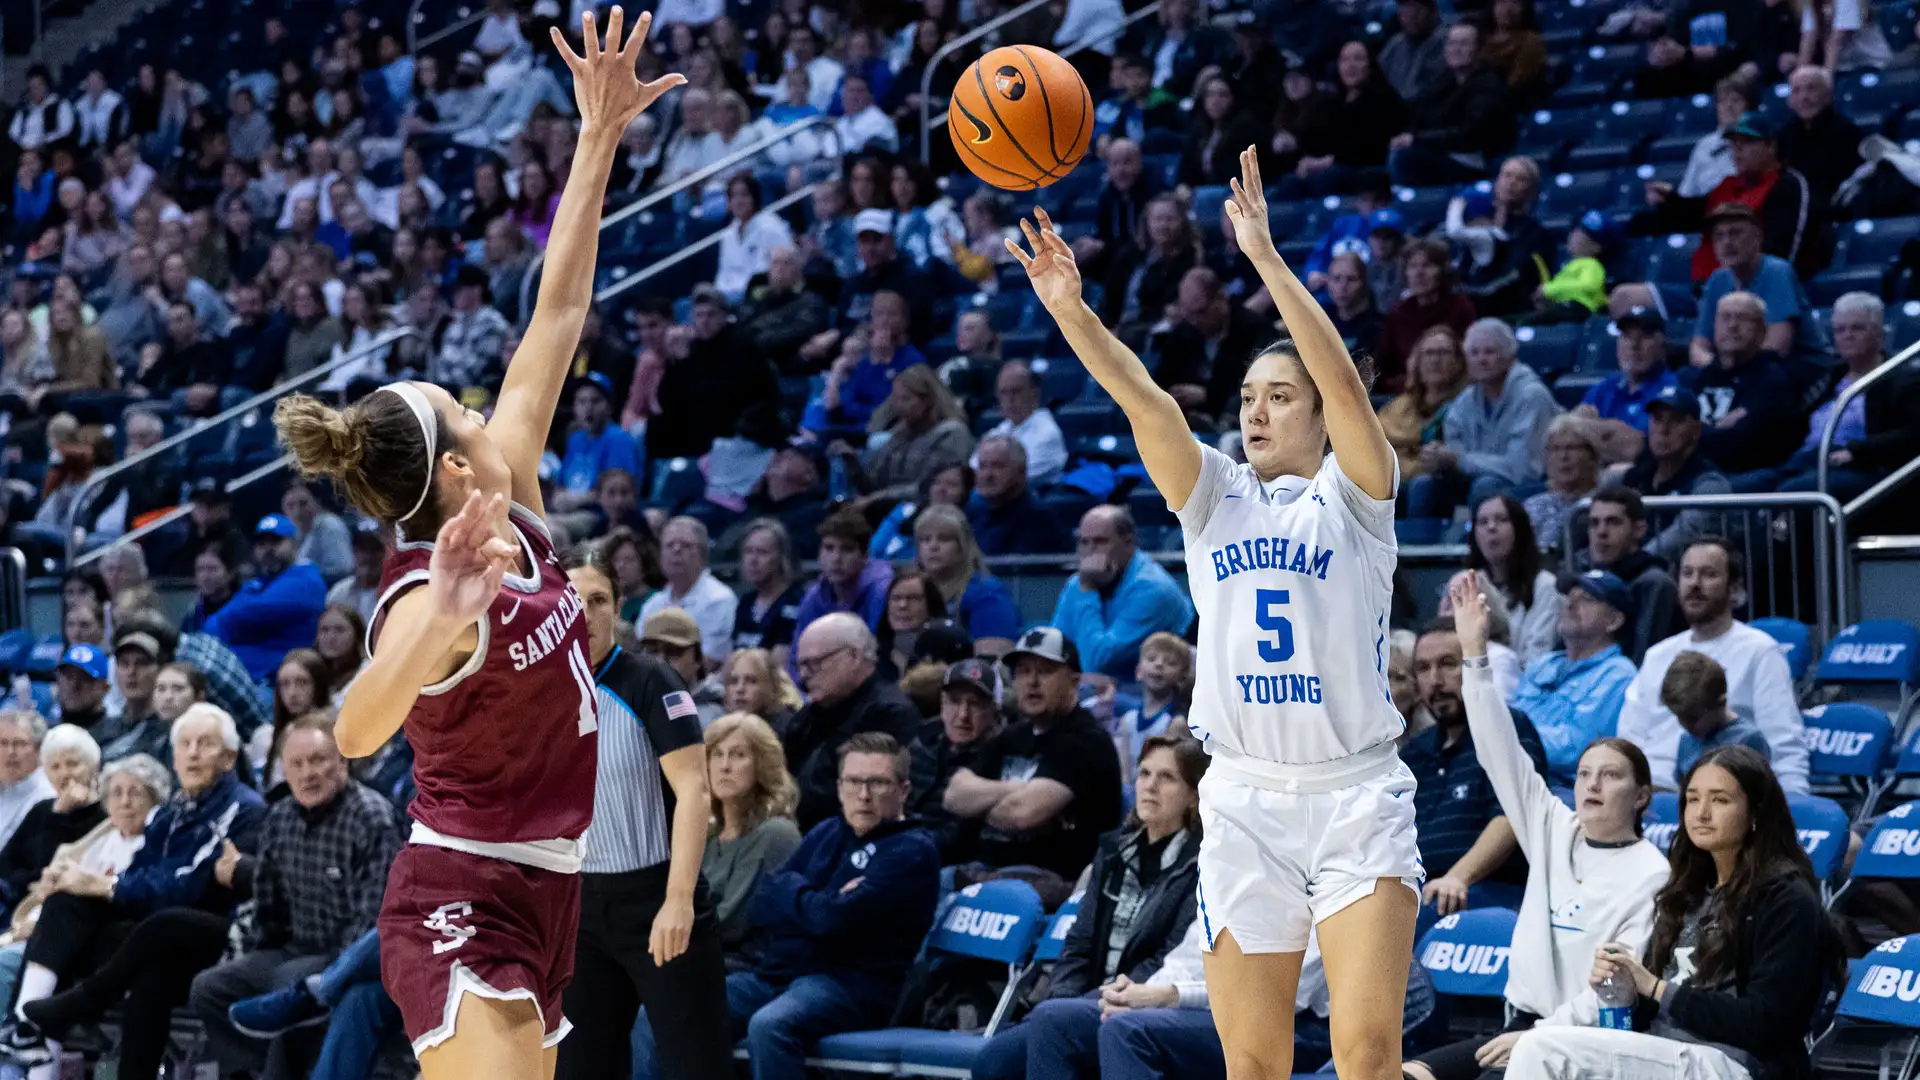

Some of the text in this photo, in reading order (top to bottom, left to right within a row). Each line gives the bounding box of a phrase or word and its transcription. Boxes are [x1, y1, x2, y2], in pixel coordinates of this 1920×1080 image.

[1211, 537, 1334, 582] BRIGHAM
[508, 610, 567, 671] SANTA
[1255, 588, 1295, 662] 5
[1828, 643, 1906, 664] BUILT
[1236, 673, 1322, 704] YOUNG
[943, 906, 1020, 940] BUILT
[1421, 940, 1513, 975] BUILT
